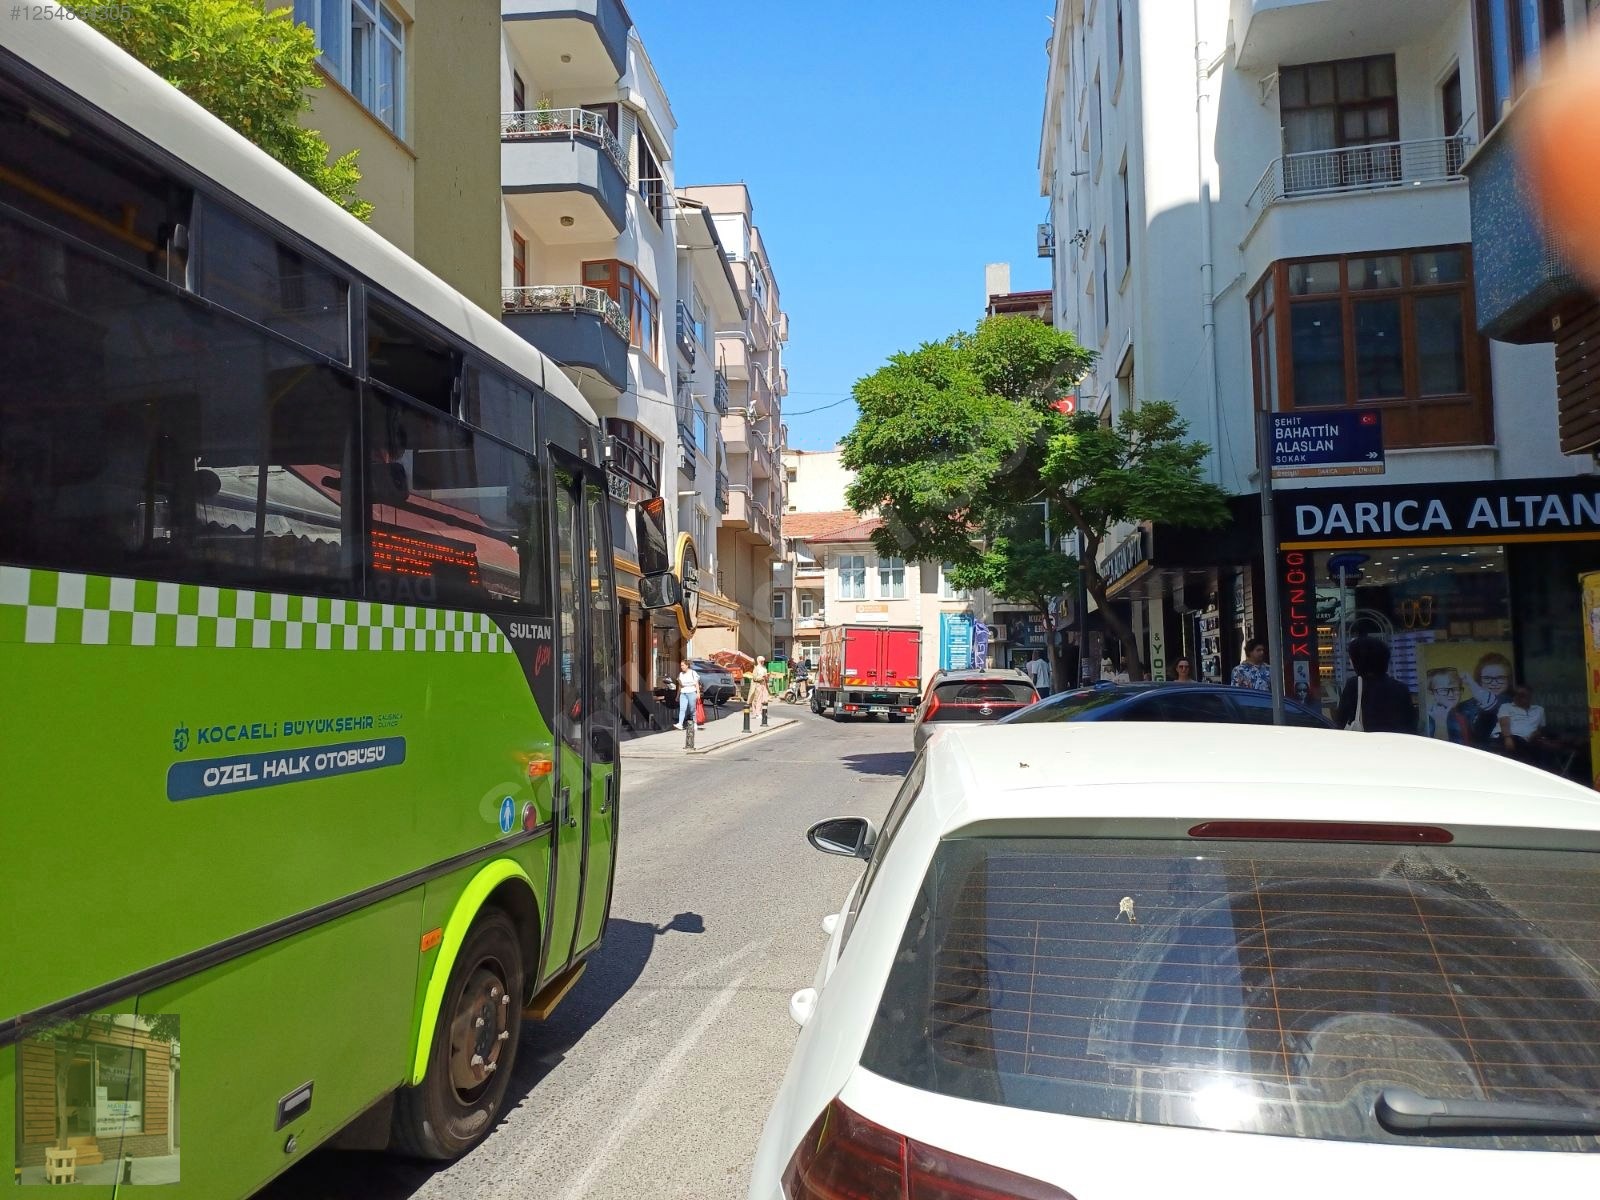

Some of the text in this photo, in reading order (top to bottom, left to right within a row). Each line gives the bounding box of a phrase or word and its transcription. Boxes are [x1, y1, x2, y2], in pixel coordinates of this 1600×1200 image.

[1274, 417, 1302, 427] ŞEHİT
[1275, 424, 1339, 439] BAHATTİN
[1275, 440, 1334, 453] ALASLAN
[1275, 454, 1306, 463] SOKAK
[1296, 494, 1600, 535] DARICA ALTAN
[1286, 552, 1311, 656] GÖZLÜK
[510, 622, 551, 640] SULTAN
[263, 756, 310, 779] HALK
[314, 745, 386, 770] OTOBÜSÜ
